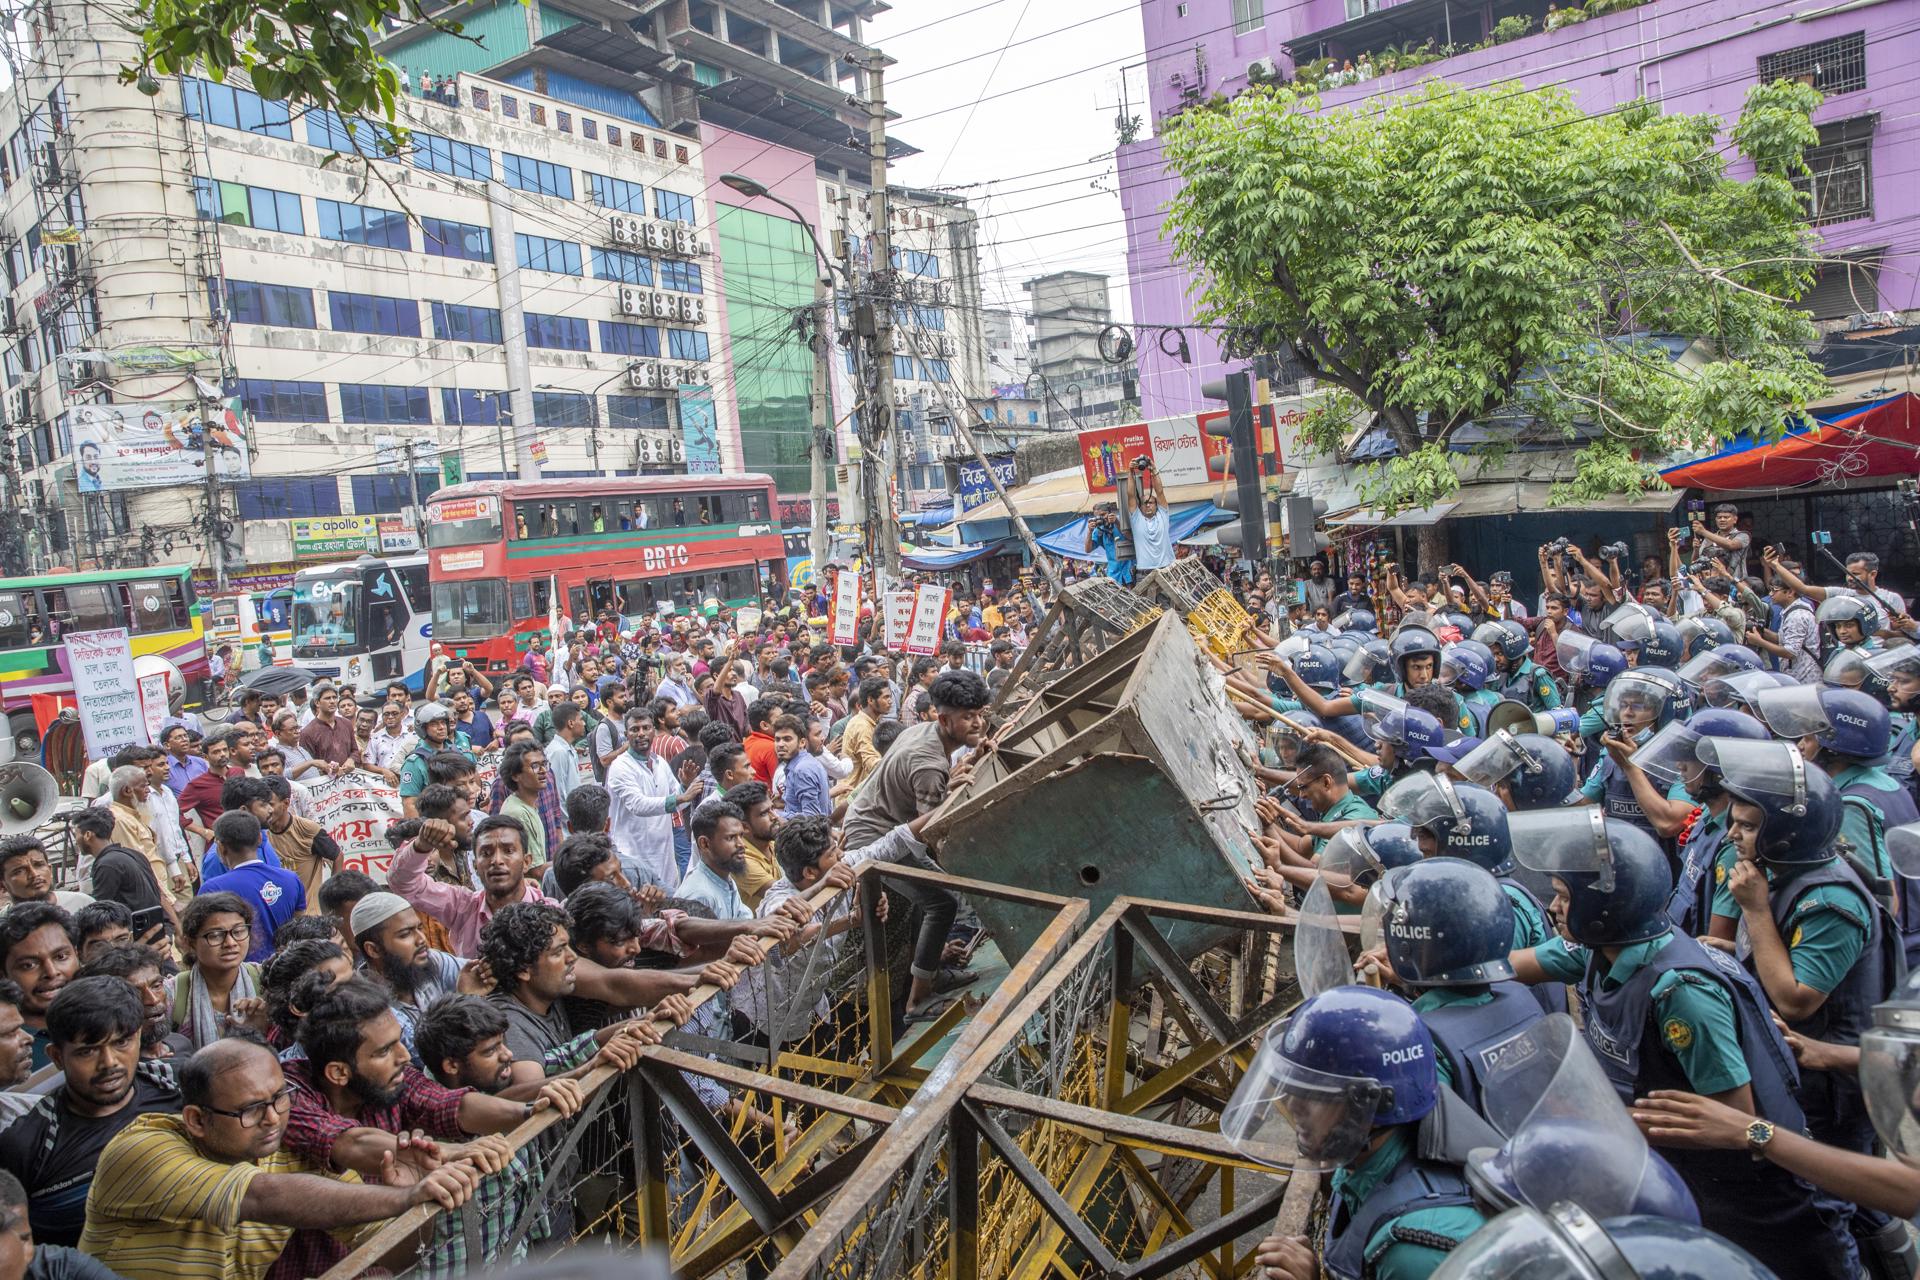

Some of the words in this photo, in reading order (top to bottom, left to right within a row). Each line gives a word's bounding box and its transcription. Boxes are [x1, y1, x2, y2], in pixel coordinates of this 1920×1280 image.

[1154, 436, 1175, 452] রিয়াদ
[960, 463, 1014, 487] বিক্রপুর
[322, 519, 359, 531] apollo
[644, 544, 689, 571] BRTC
[1864, 609, 1876, 622] POLICE
[1505, 635, 1522, 646] POLICE
[1704, 637, 1721, 648] POLIC
[1646, 647, 1668, 657] POLICE
[84, 664, 102, 675] চাল,
[1469, 662, 1484, 673] POLICE
[1592, 664, 1609, 673] POLICE
[93, 677, 121, 691] তেলসহ
[1672, 698, 1690, 710] POLICE
[1836, 713, 1868, 728] POLICE
[96, 729, 111, 741] দাম
[1408, 731, 1430, 742] POLICE
[1613, 802, 1643, 814] POLIC
[1448, 835, 1490, 846] POLICE
[1390, 924, 1432, 939] POLICE
[1382, 1044, 1424, 1066] POLICE
